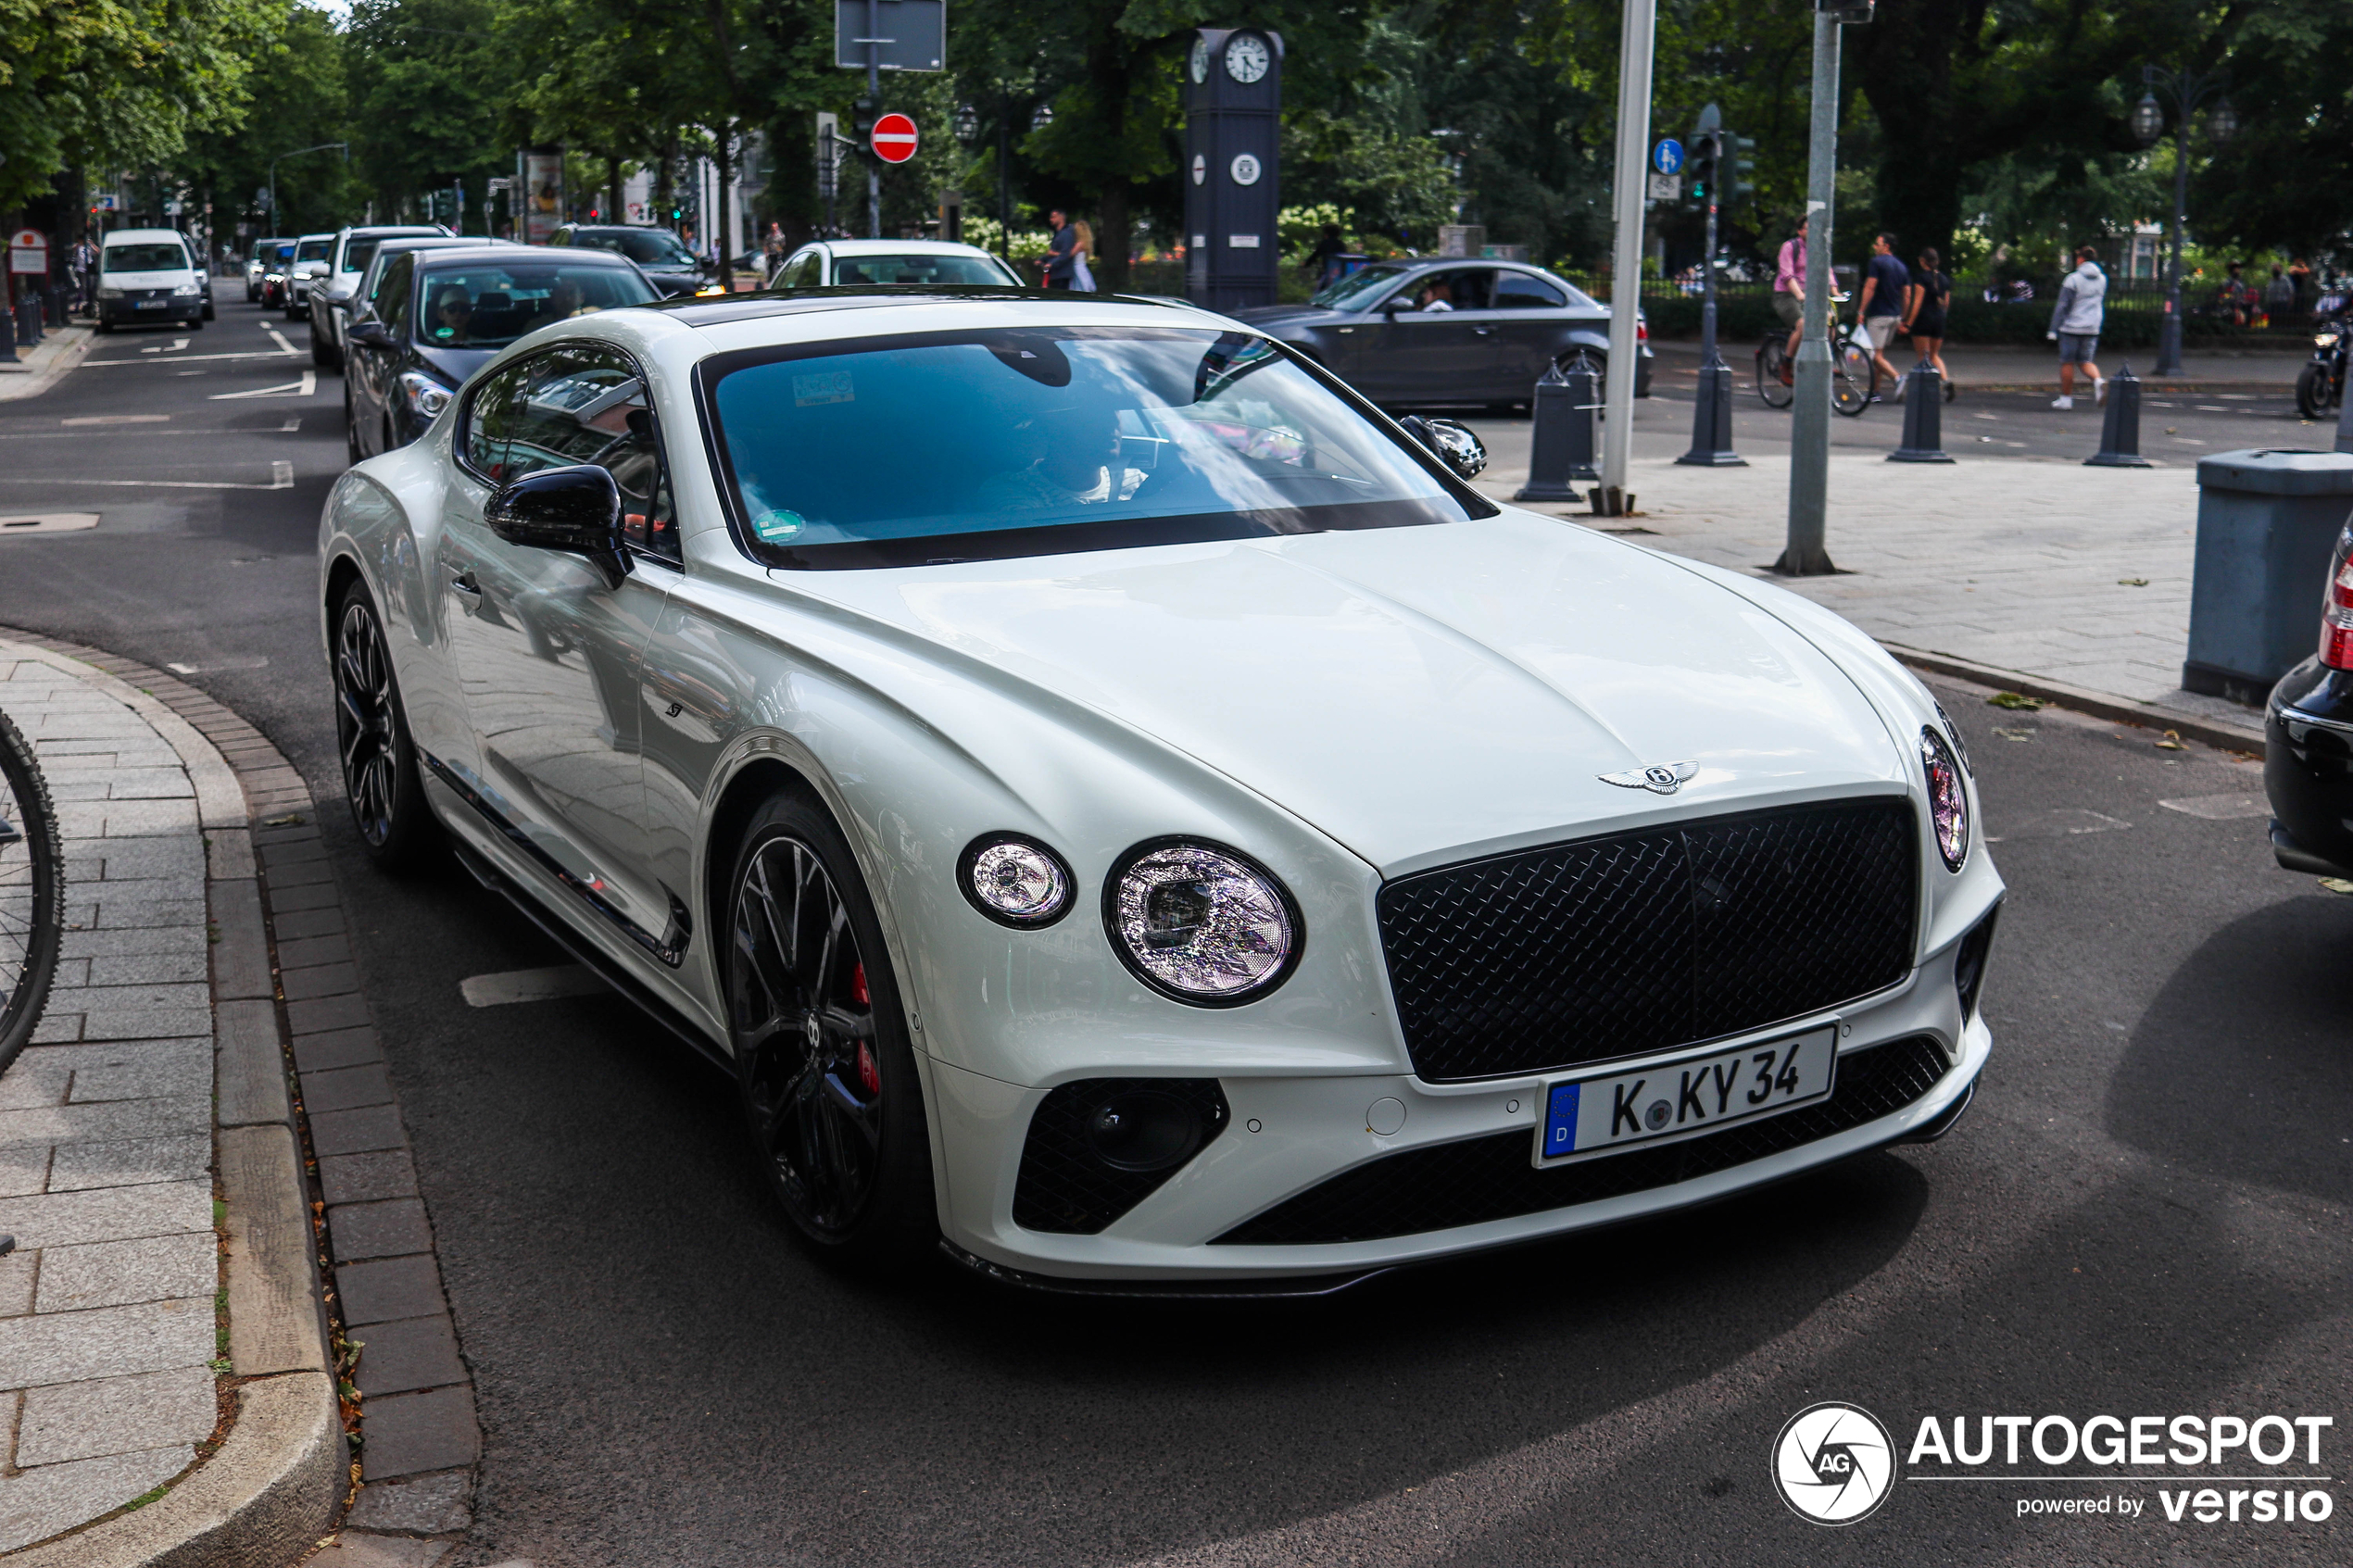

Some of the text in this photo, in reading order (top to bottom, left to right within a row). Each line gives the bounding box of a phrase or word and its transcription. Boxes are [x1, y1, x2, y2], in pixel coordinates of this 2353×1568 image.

[44, 819, 59, 856] SAM
[52, 863, 61, 926] SMART
[1611, 1079, 1646, 1136] K
[1556, 1127, 1567, 1142] D
